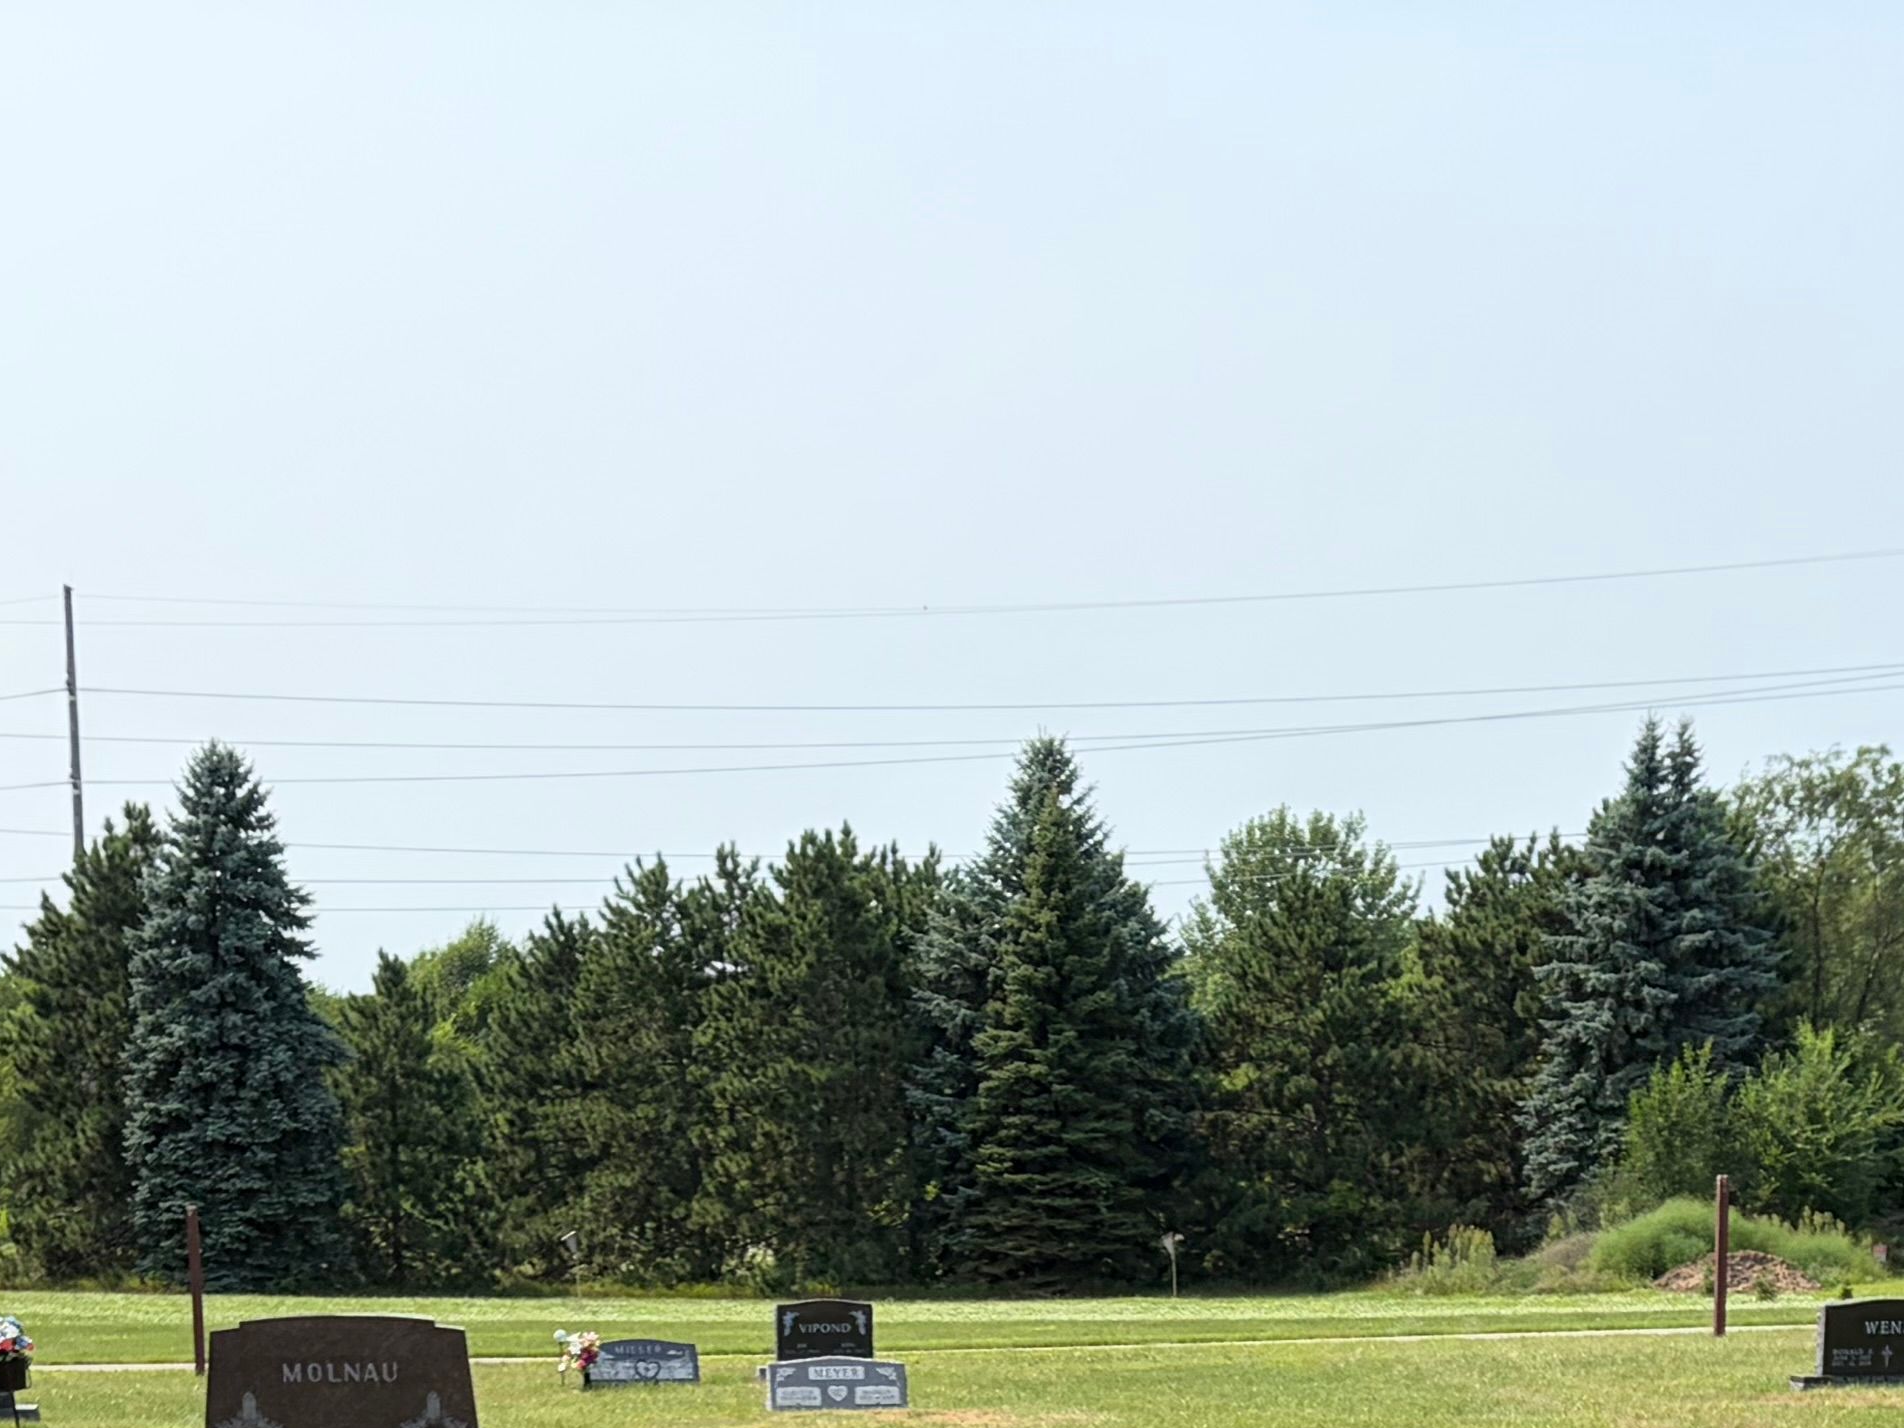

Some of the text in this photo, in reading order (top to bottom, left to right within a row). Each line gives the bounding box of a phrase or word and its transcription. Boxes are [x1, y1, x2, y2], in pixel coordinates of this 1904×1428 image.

[798, 1322, 852, 1334] VIPOND
[282, 1362, 399, 1383] MOLNAU
[814, 1367, 858, 1379] MEYER
